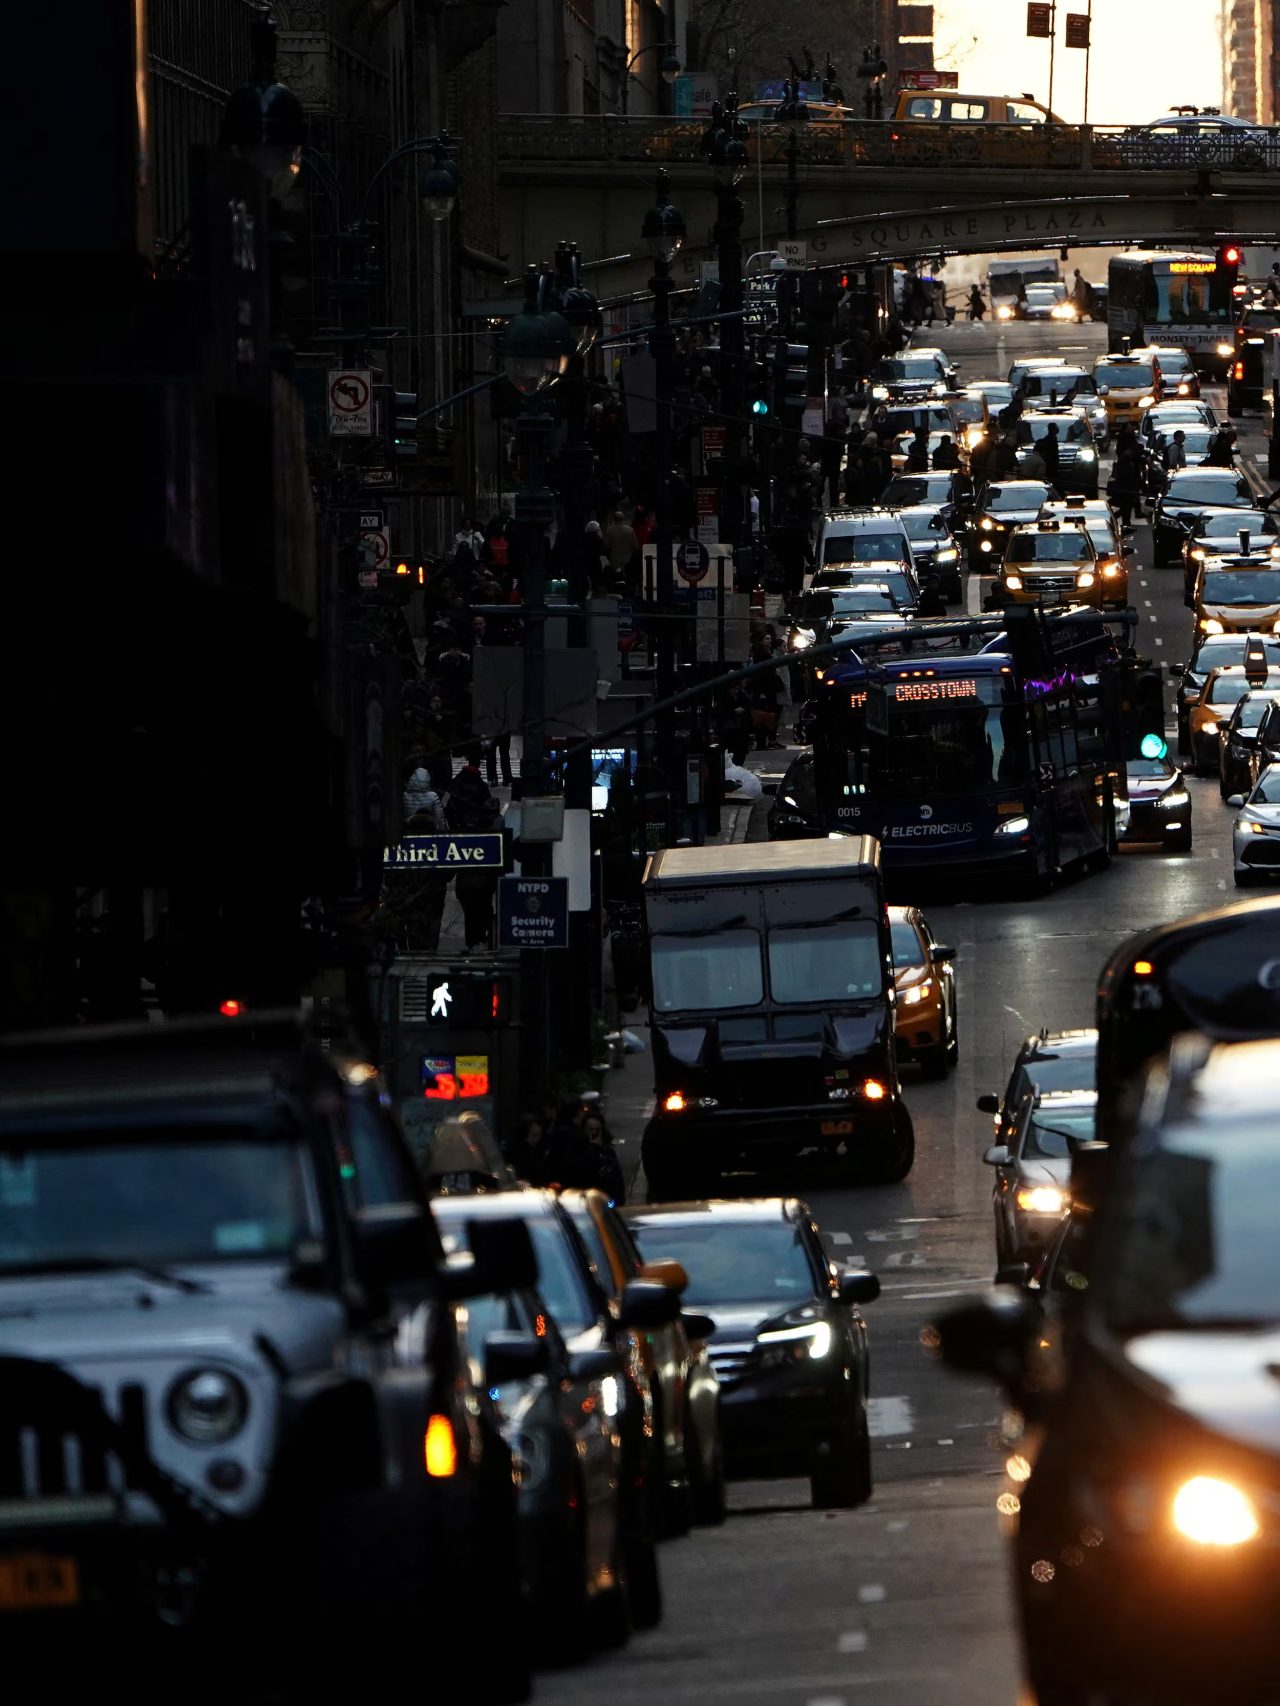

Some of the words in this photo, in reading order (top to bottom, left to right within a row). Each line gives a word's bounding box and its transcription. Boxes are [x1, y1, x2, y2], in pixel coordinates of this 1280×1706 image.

[852, 218, 979, 249] SQUARE
[1004, 212, 1106, 233] PLAZA
[785, 245, 799, 255] NO
[1150, 334, 1190, 343] MONSEY
[896, 680, 977, 702] CROSSTOWN
[837, 807, 861, 818] 0015
[383, 842, 439, 863] Third
[445, 842, 485, 862] Ave
[517, 882, 550, 893] NYPD
[511, 915, 555, 927] Security
[511, 926, 555, 938] Camera
